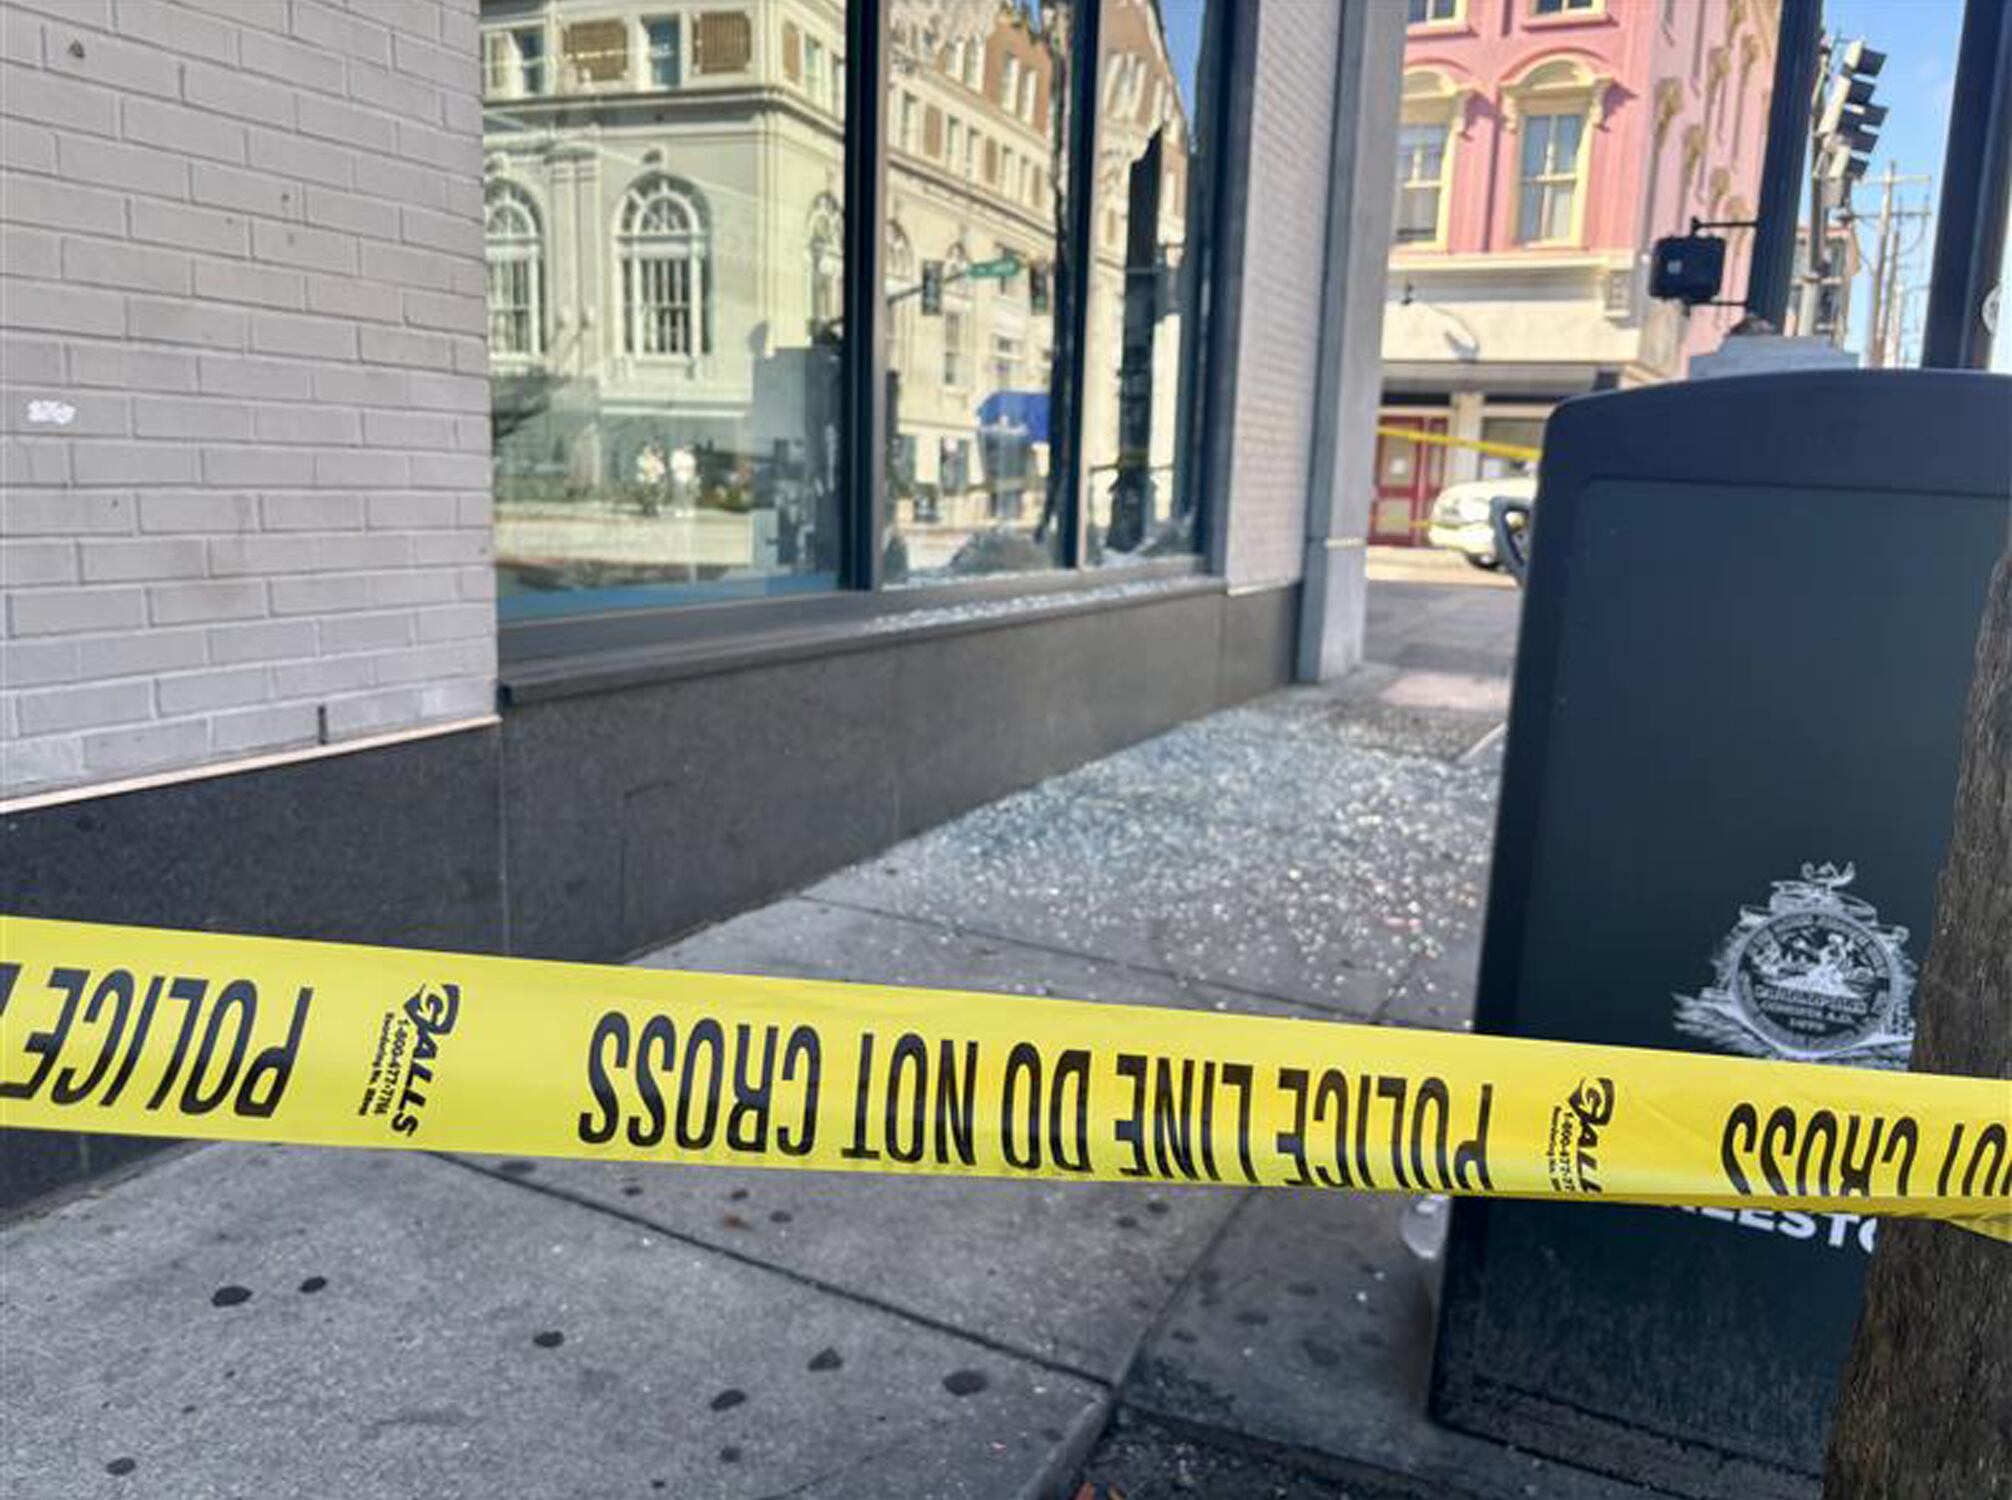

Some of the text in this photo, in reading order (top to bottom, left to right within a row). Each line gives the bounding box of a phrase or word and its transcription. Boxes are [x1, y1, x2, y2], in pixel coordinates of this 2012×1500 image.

[0, 967, 312, 1118] POLICE
[391, 984, 460, 1137] GALLS
[579, 1011, 1496, 1194] POLICE LINE DO NOT CROSS
[1722, 1103, 2012, 1198] OT CROSS
